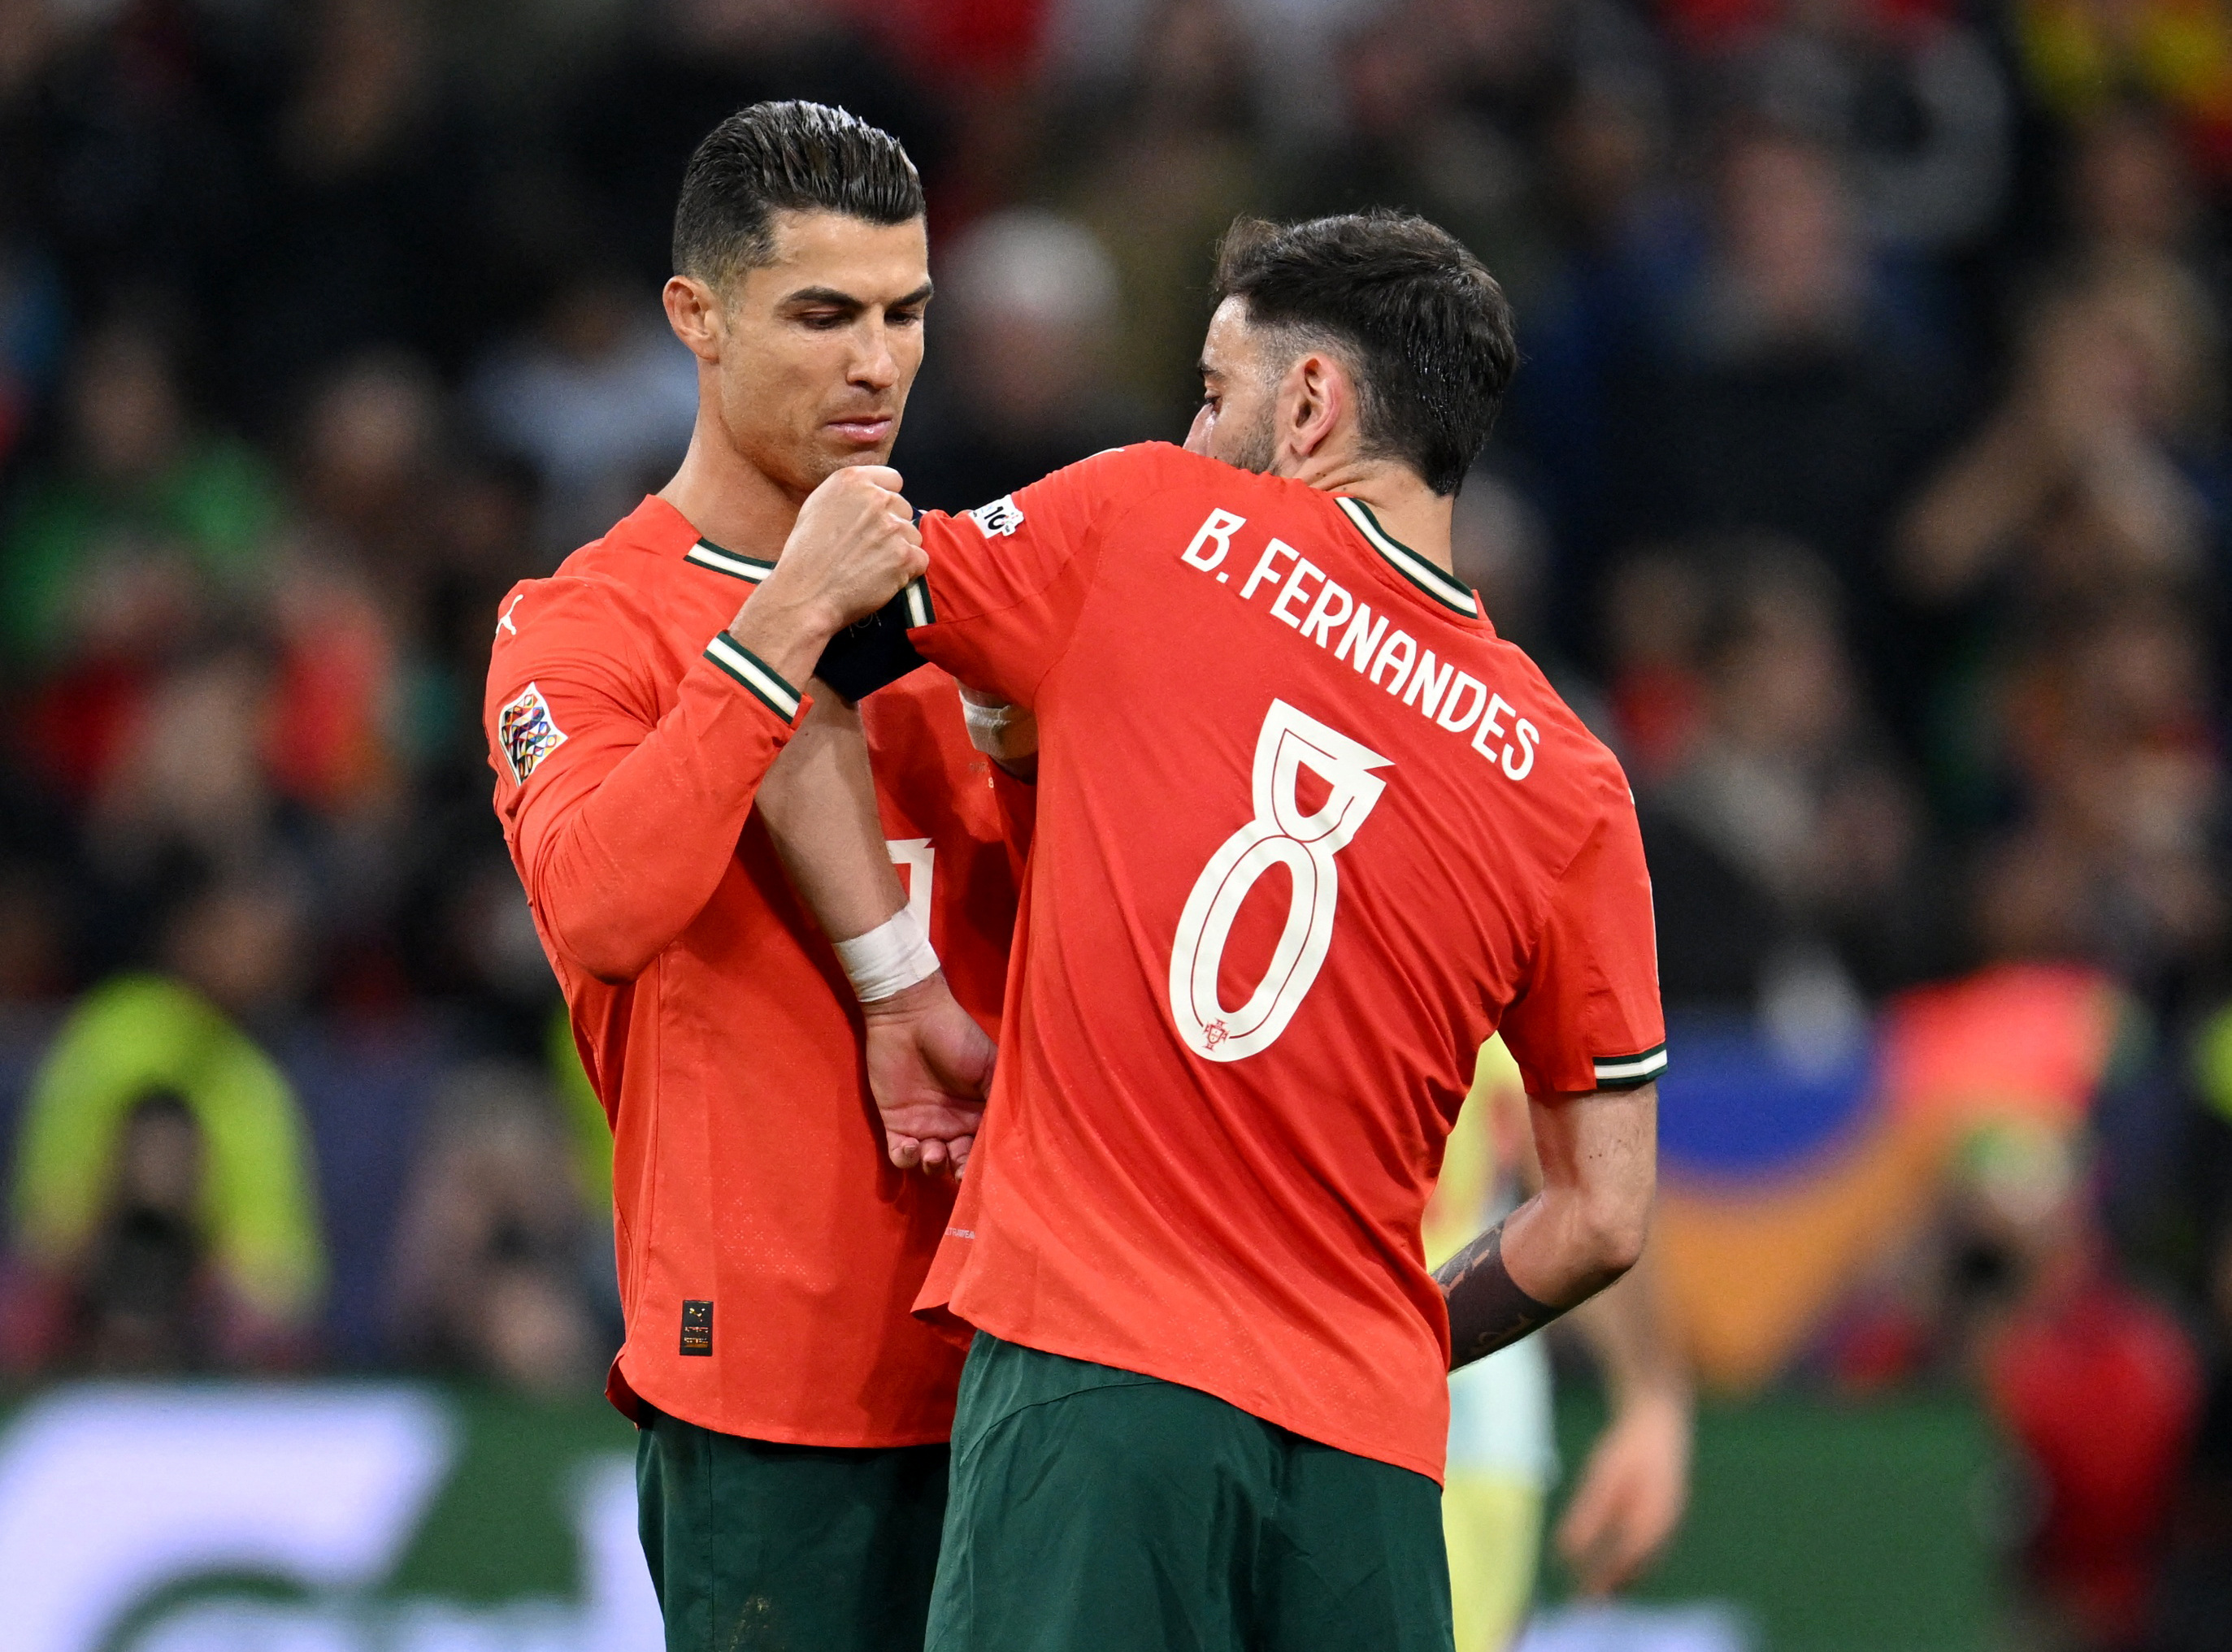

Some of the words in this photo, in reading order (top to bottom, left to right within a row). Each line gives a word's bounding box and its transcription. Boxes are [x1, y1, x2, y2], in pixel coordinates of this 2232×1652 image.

[1181, 507, 1246, 583] B.
[1240, 537, 1539, 781] FERNANDES
[1169, 697, 1396, 1062] 8
